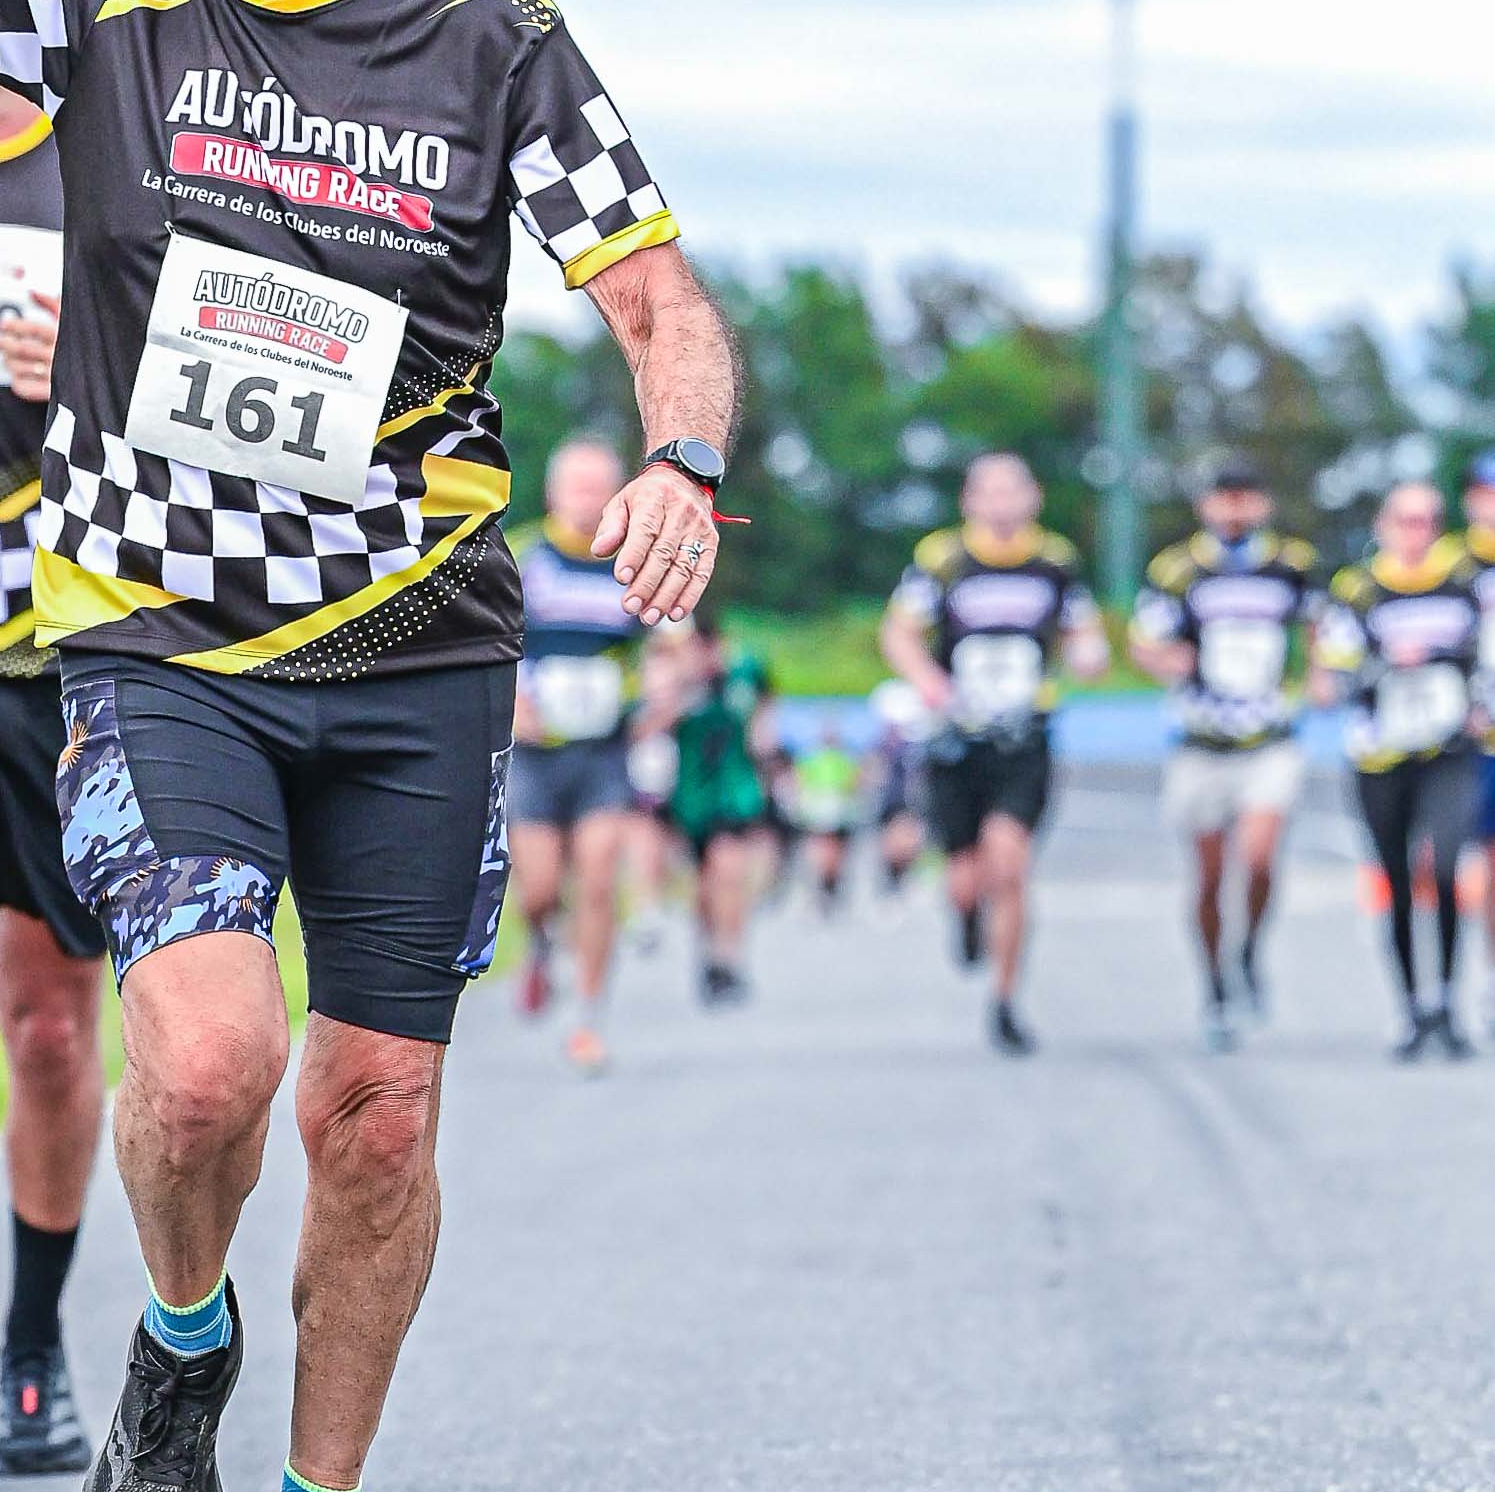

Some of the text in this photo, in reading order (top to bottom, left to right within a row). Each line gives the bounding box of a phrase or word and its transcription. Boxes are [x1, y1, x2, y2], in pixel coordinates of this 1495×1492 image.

[142, 169, 450, 257] La Carrera de los Clubes del Noroeste
[202, 141, 403, 220] RUNNING RACE
[193, 270, 369, 343] AUTÓDROMO
[215, 310, 330, 356] RUNNING RACE
[180, 326, 353, 381] La Carrera de los Clubes del Noroeste
[169, 360, 326, 462] 161
